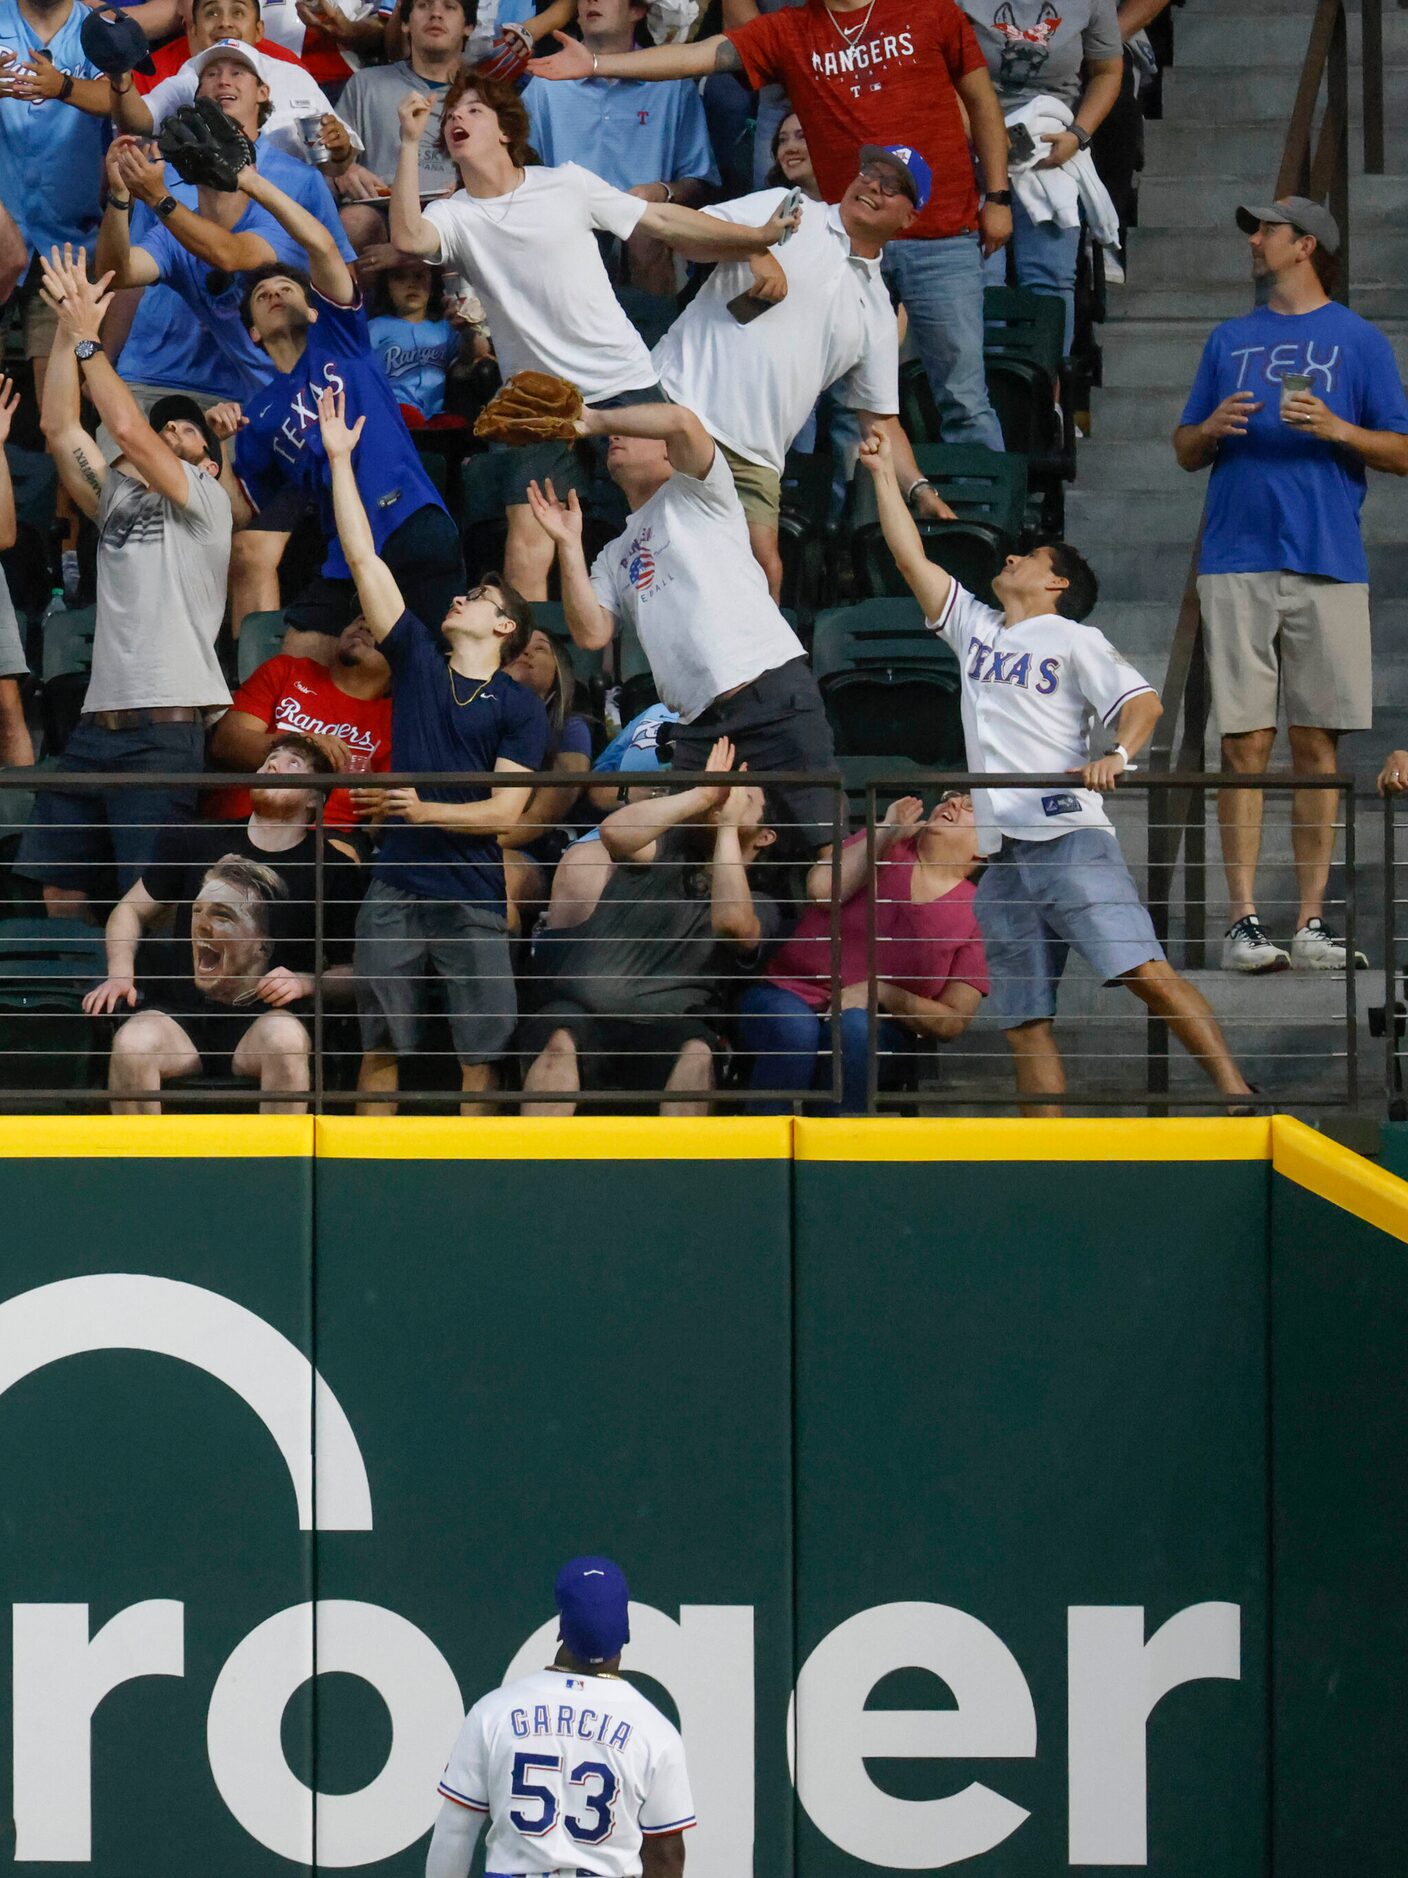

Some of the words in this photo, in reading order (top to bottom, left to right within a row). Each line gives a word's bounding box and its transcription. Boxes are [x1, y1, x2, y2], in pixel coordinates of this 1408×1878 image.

[812, 32, 914, 76] RANGERS
[850, 85, 861, 98] T
[1231, 340, 1339, 393] TEX
[272, 362, 344, 464] TEXAS
[275, 697, 375, 752] Rangers
[511, 1705, 632, 1754] GARCIA
[510, 1752, 620, 1845] 53
